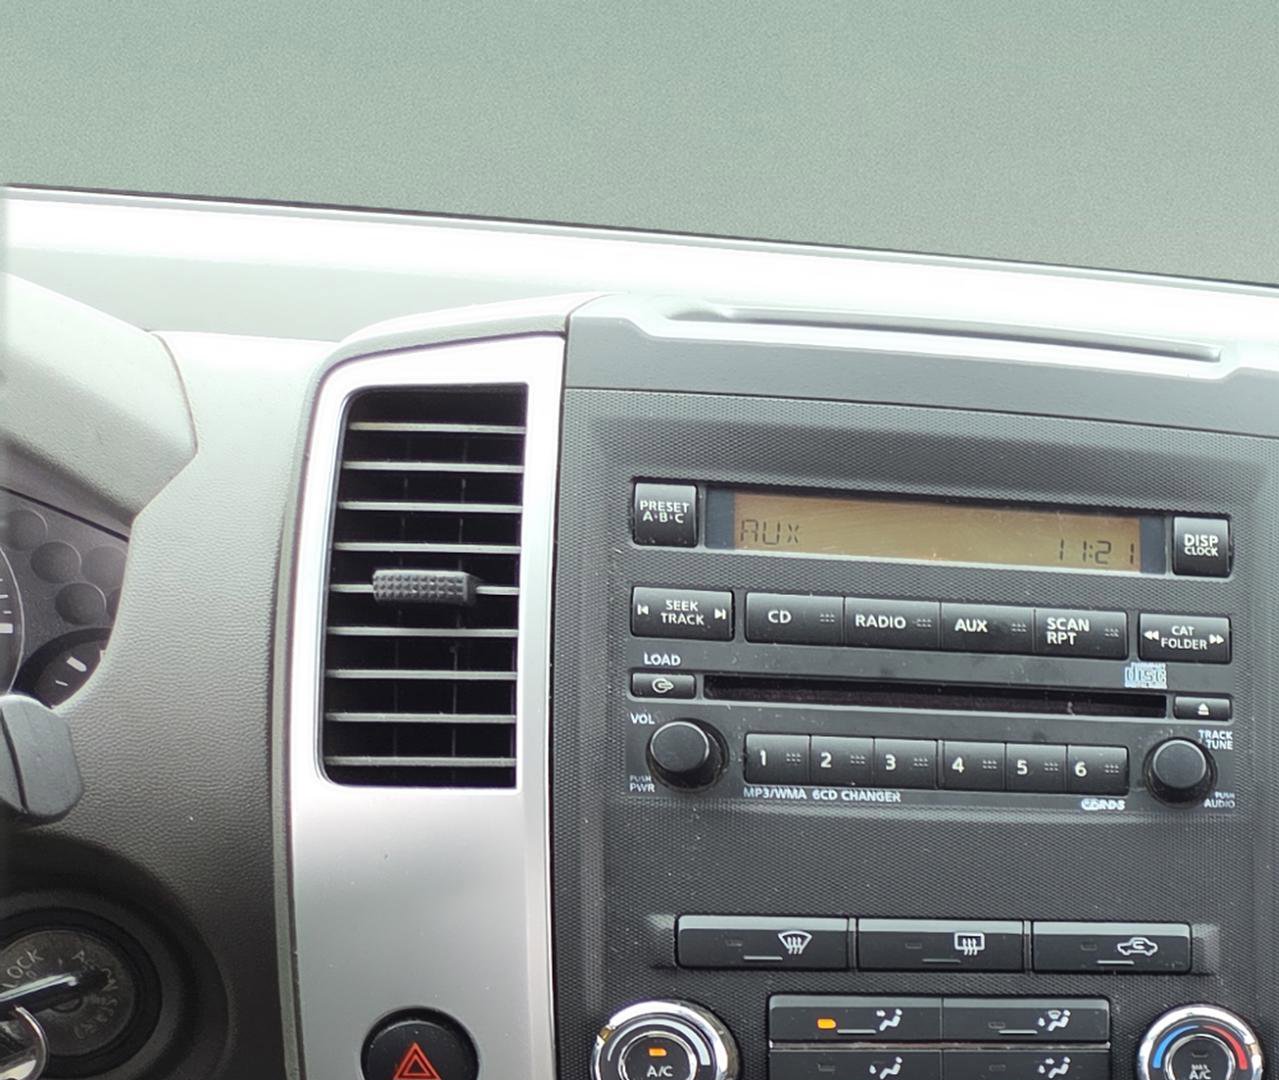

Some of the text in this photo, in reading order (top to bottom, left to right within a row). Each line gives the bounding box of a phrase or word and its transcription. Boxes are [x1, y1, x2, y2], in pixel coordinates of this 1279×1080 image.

[640, 500, 690, 514] PRESET
[739, 519, 801, 545] AUX
[1184, 534, 1219, 547] DISP
[1184, 546, 1219, 557] CLOCK
[665, 600, 699, 612] SEEK
[660, 612, 705, 626] TRACK
[767, 610, 792, 624] CD
[855, 614, 907, 629] RADIO
[954, 618, 989, 633] AUX
[1046, 617, 1090, 632] SCAN
[1171, 625, 1195, 636] CAT
[1046, 632, 1077, 646] RPT
[1161, 637, 1208, 650] FOLDER
[644, 653, 682, 666] LOAD
[630, 713, 655, 725] VOL
[1198, 729, 1233, 740] TRACK
[1206, 739, 1234, 750] TUNE
[759, 750, 767, 766] 1
[820, 752, 832, 768] 2
[885, 754, 897, 770] 3
[951, 756, 965, 773] 4
[1016, 759, 1028, 775] 5
[1074, 761, 1087, 777] 6
[629, 783, 656, 793] PWR
[743, 786, 901, 802] MP3/WMA 6CD CHANGER
[1204, 798, 1236, 809] AUDIO
[646, 1064, 674, 1079] A/C
[1189, 1070, 1212, 1080] A/C
